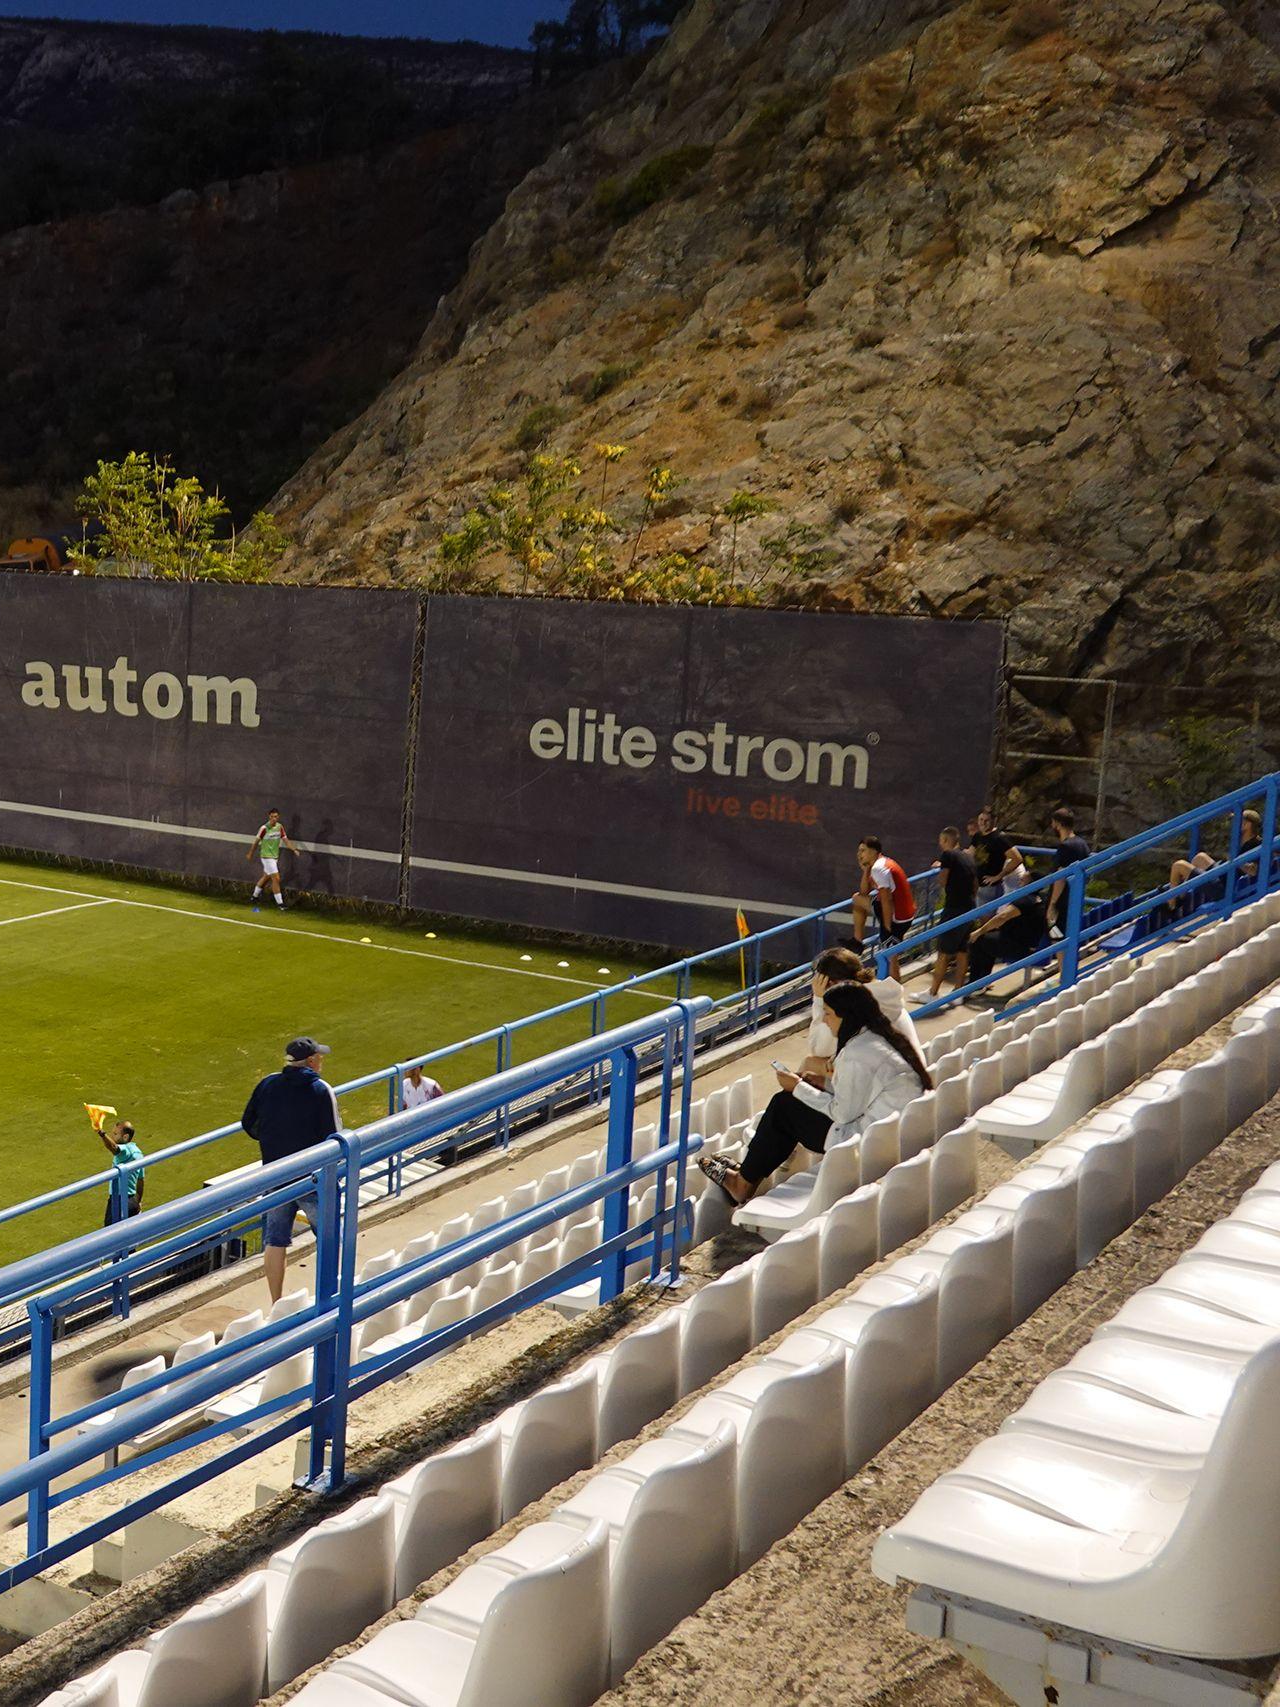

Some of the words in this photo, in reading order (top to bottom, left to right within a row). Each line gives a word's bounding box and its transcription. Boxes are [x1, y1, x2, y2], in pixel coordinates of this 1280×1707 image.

[21, 656, 261, 728] autom
[529, 707, 657, 768] elite
[686, 787, 741, 817] live
[749, 793, 820, 826] elite
